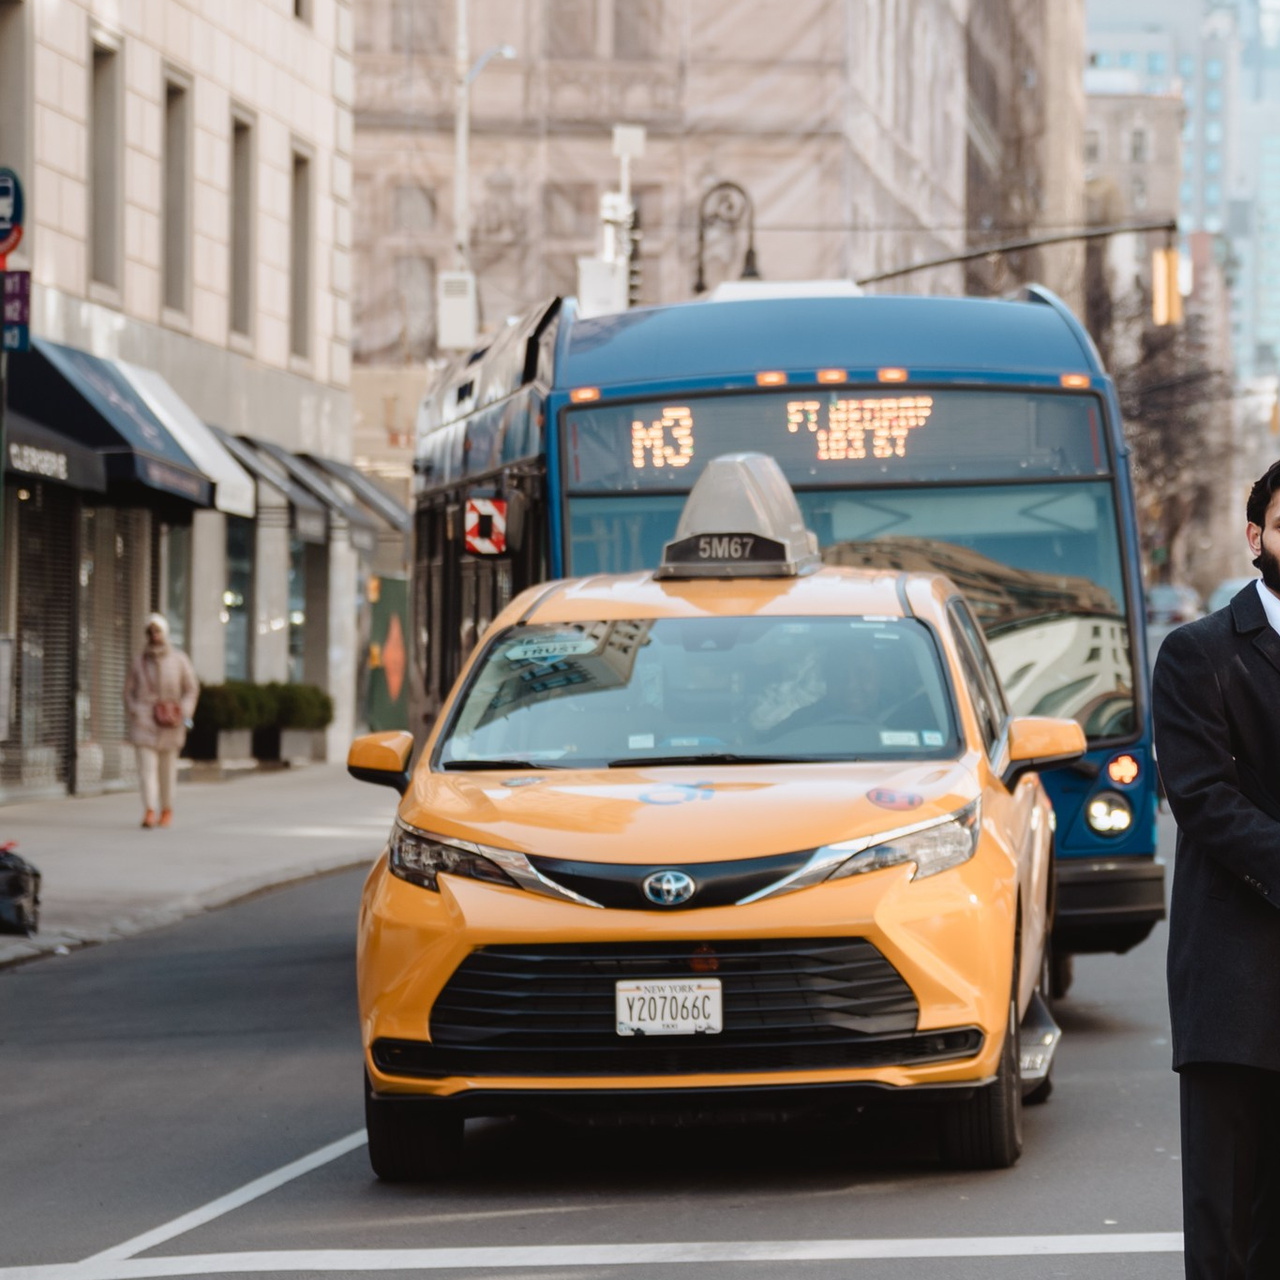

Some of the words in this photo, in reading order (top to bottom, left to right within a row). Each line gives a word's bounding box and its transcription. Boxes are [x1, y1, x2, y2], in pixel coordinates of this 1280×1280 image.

[631, 406, 694, 468] M3
[699, 536, 754, 558] 5M67
[521, 644, 579, 657] TRUST
[644, 985, 667, 994] NEW
[669, 984, 695, 994] YORK
[626, 995, 711, 1022] Y207066C
